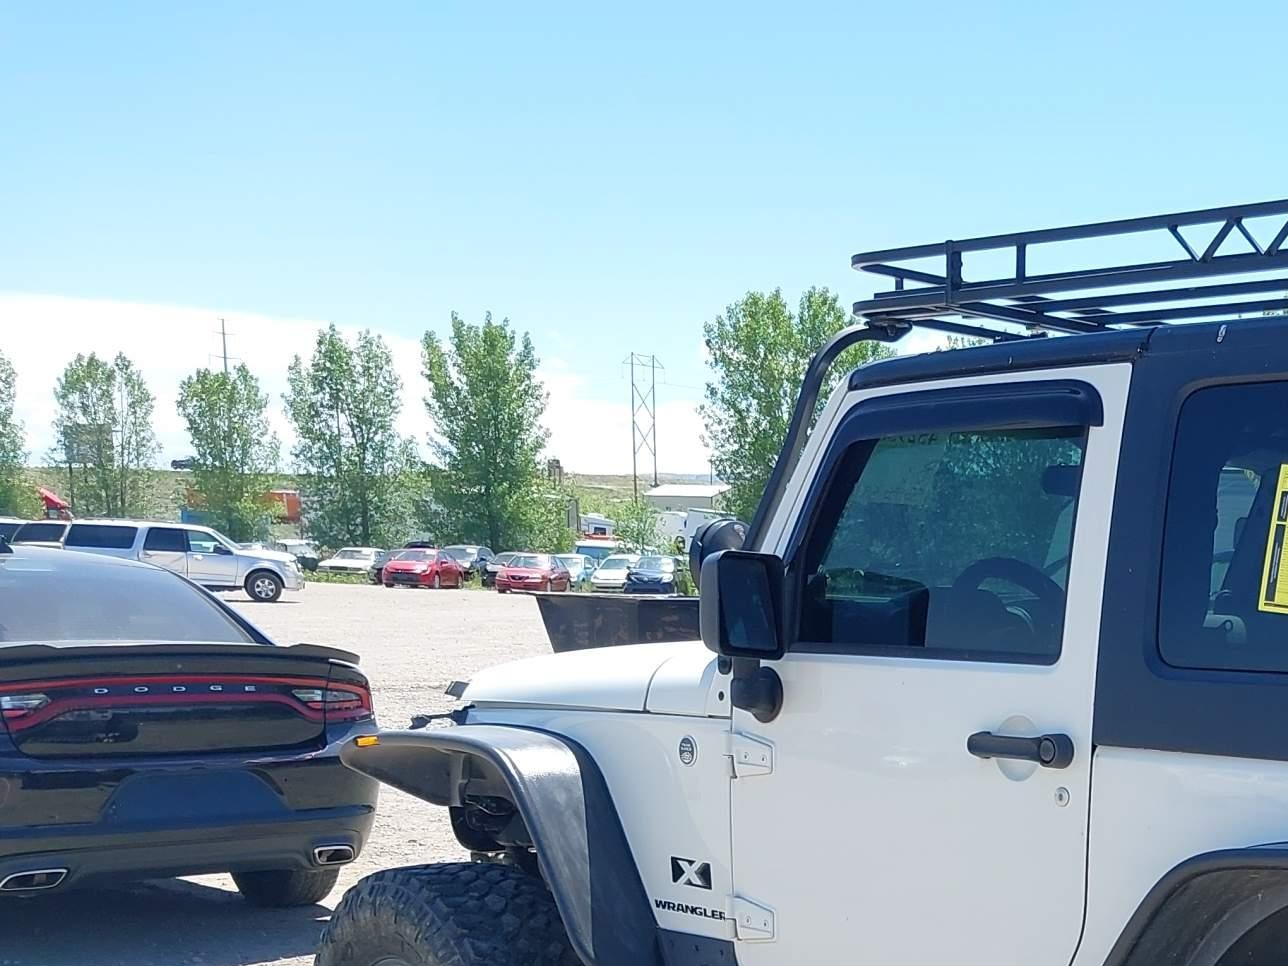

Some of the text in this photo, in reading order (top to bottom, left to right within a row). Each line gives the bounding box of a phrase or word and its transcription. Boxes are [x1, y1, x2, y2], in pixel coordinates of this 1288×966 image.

[94, 685, 257, 694] DODGE
[672, 857, 707, 888] X
[654, 898, 726, 921] WRANGLER
